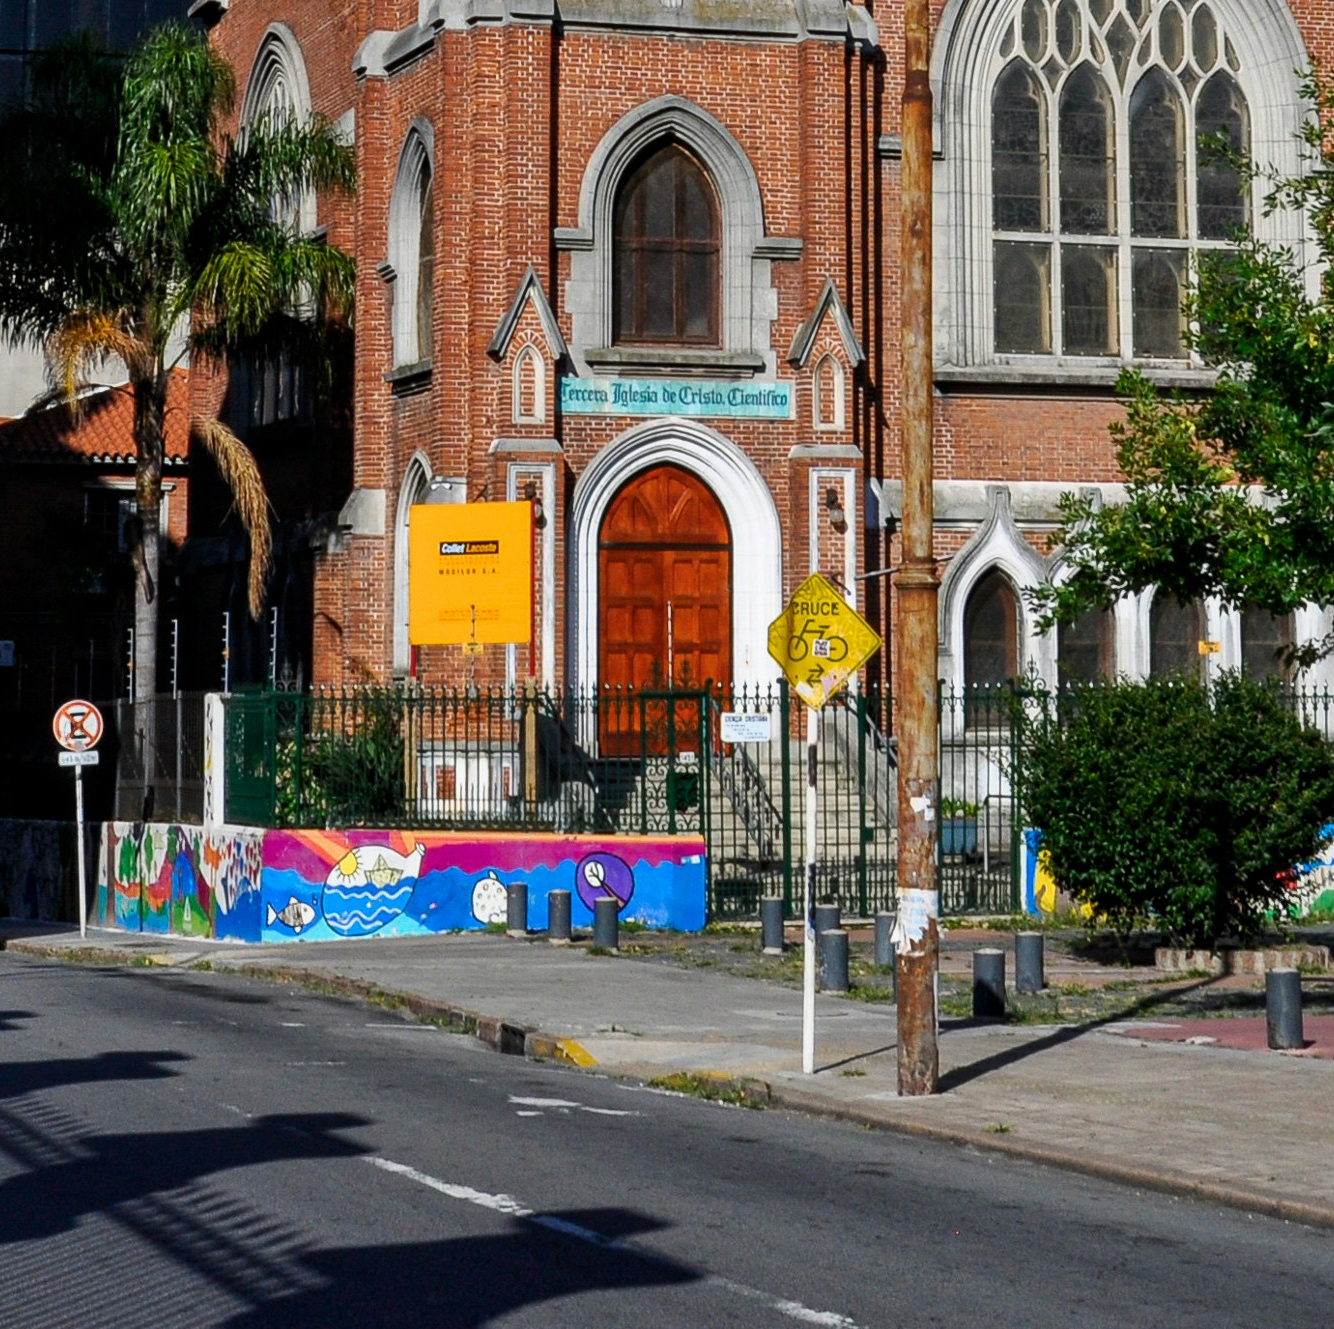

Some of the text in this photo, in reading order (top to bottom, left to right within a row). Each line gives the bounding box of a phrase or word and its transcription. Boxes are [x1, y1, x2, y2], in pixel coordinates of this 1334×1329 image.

[561, 382, 609, 402] Tercera
[611, 382, 659, 407] Iglesia
[662, 385, 677, 404] de
[791, 601, 840, 616] CRUCE
